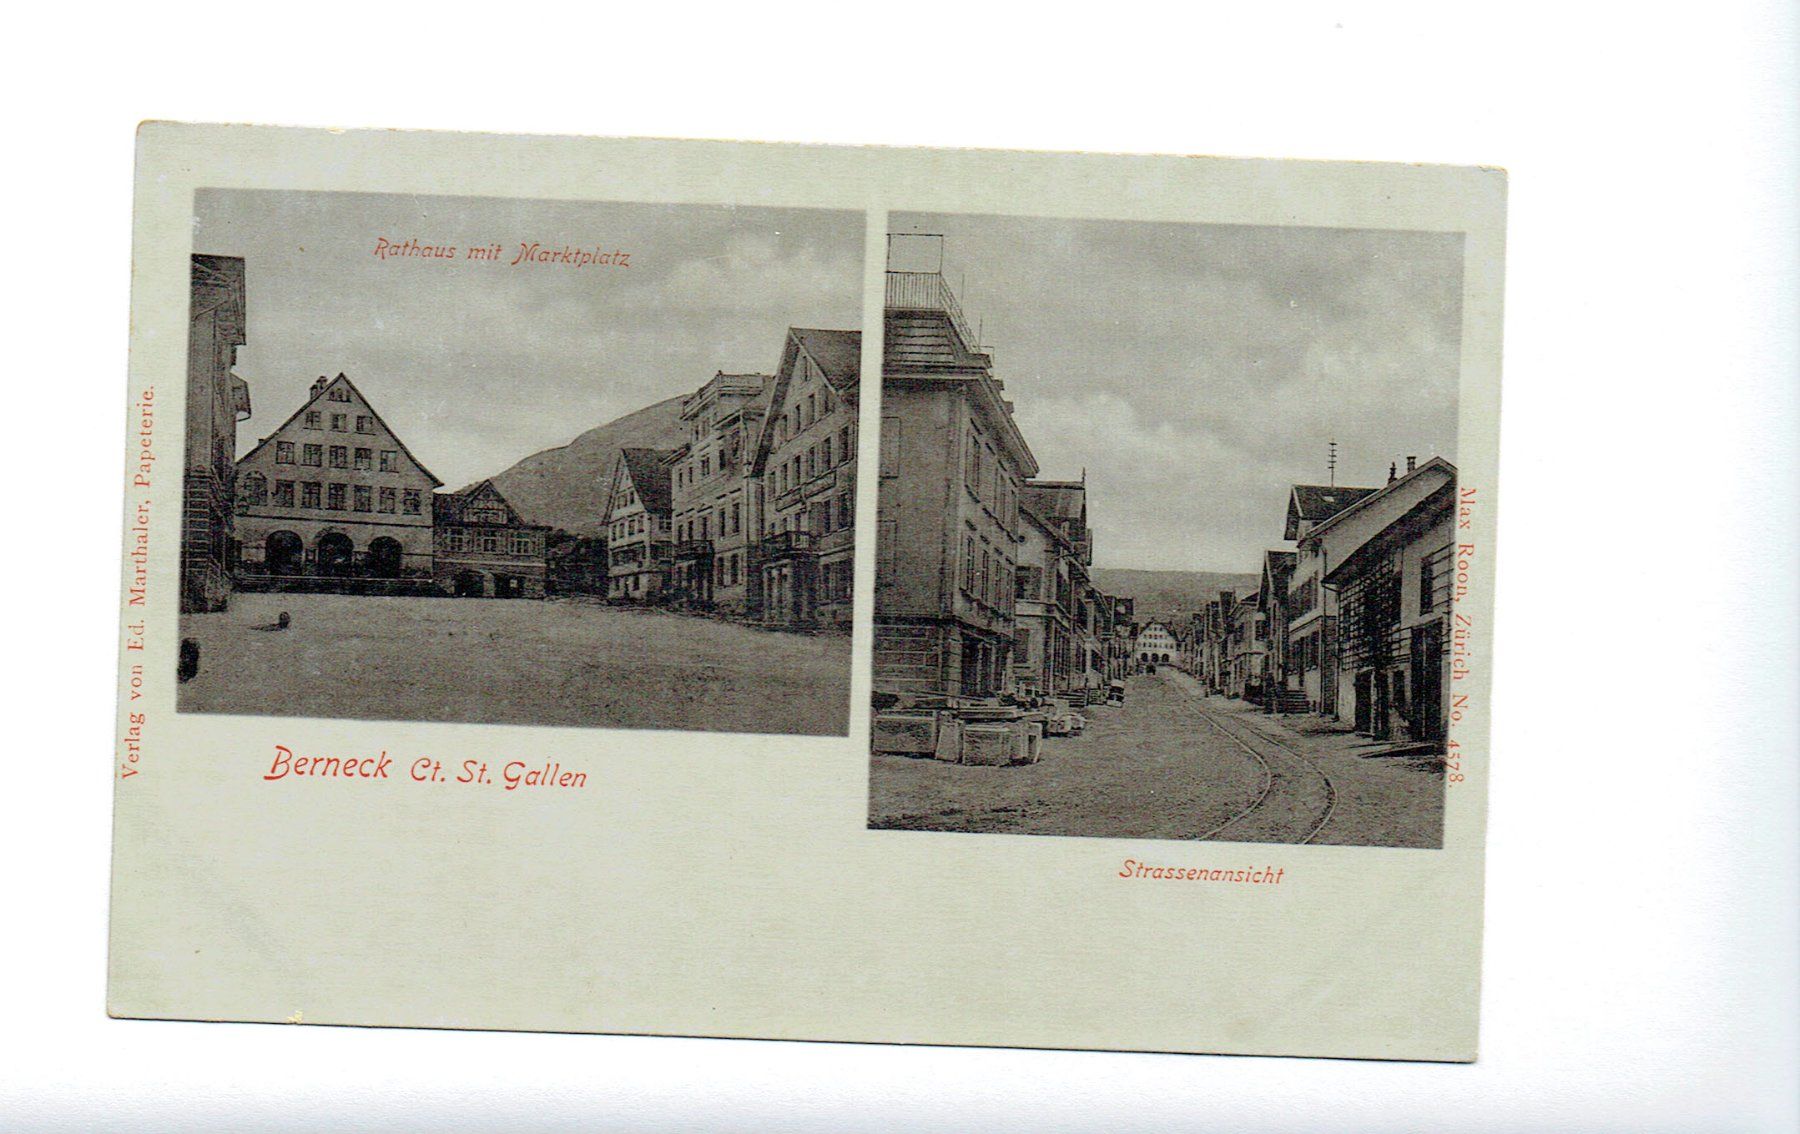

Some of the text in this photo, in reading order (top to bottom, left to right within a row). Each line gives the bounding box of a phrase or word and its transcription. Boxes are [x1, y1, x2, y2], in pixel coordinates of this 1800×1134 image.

[373, 236, 632, 268] Rathaus mit Marktplatz
[121, 385, 155, 780] Verlag von Ed. Marthaler, Papeterie.
[1446, 487, 1477, 789] Max Roon, Zürich No. 4578.
[263, 743, 588, 792] Berneck Ct. St. Gallen
[1118, 859, 1285, 886] Strassenansicht
